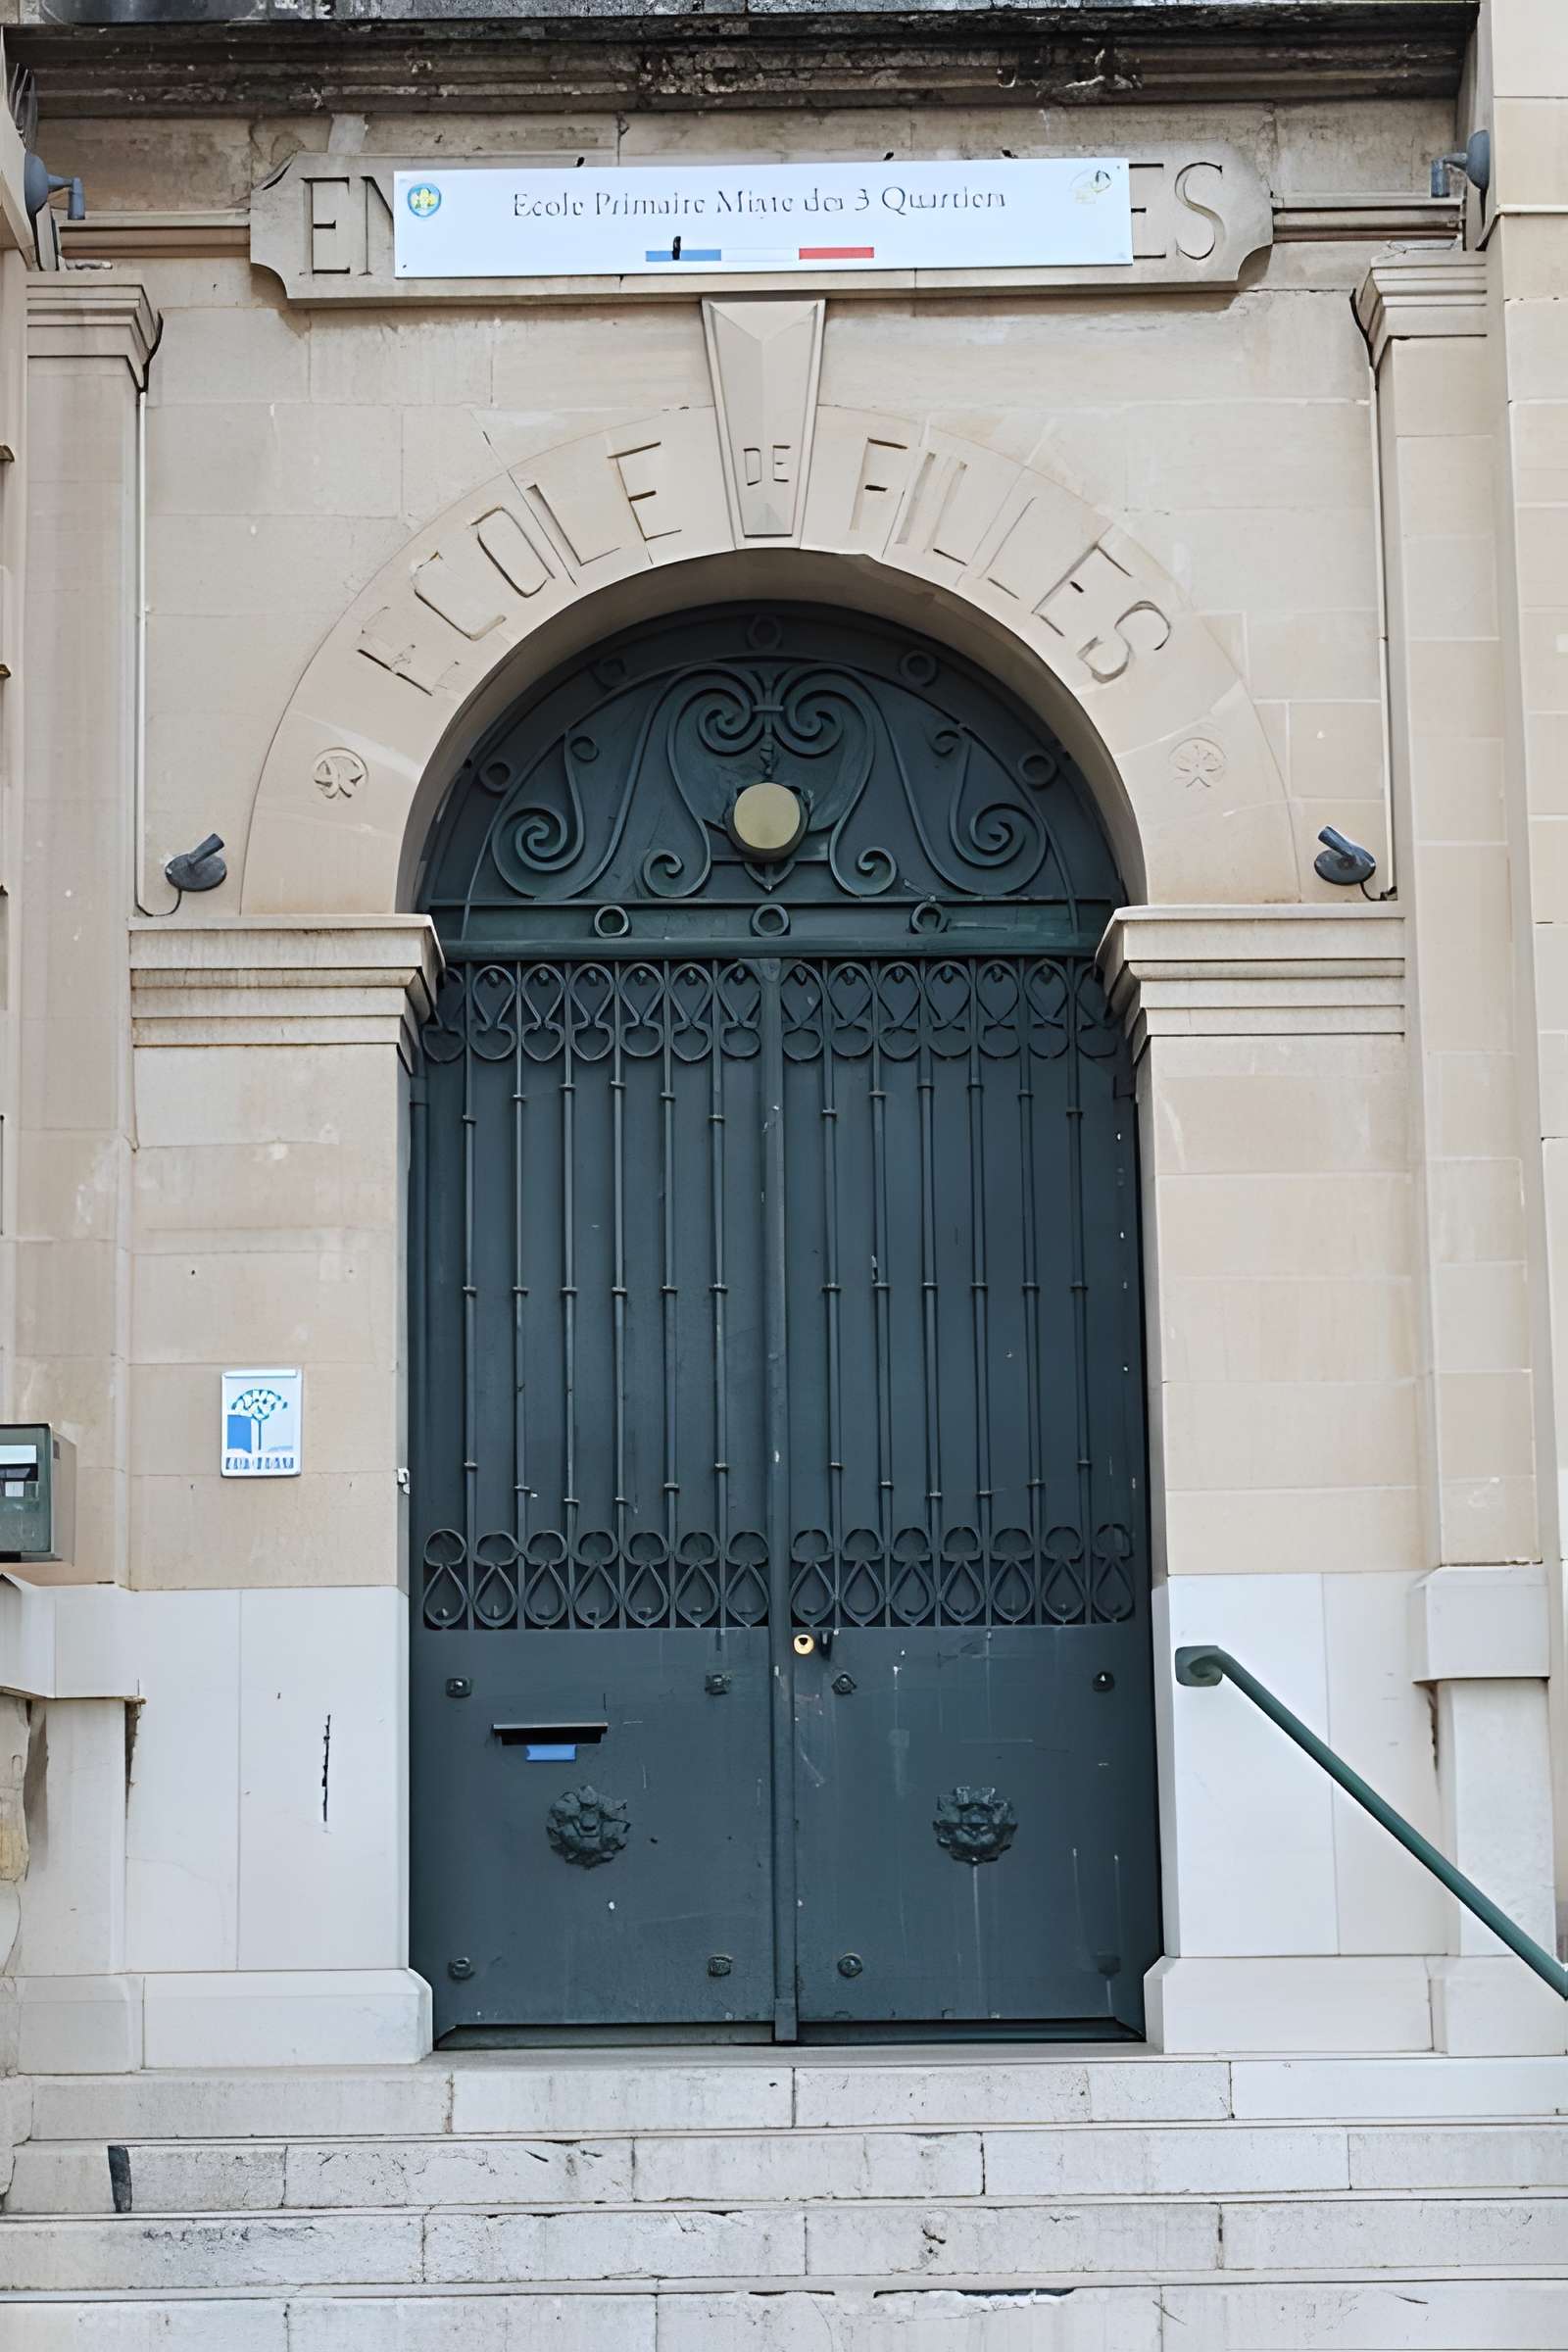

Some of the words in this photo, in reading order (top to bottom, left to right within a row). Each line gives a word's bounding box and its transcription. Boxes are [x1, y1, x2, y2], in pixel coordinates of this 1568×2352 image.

[513, 191, 585, 218] Ecole
[595, 191, 706, 217] Primaire
[854, 188, 870, 212] 3
[743, 444, 792, 487] DE
[849, 437, 1172, 685] FILLES
